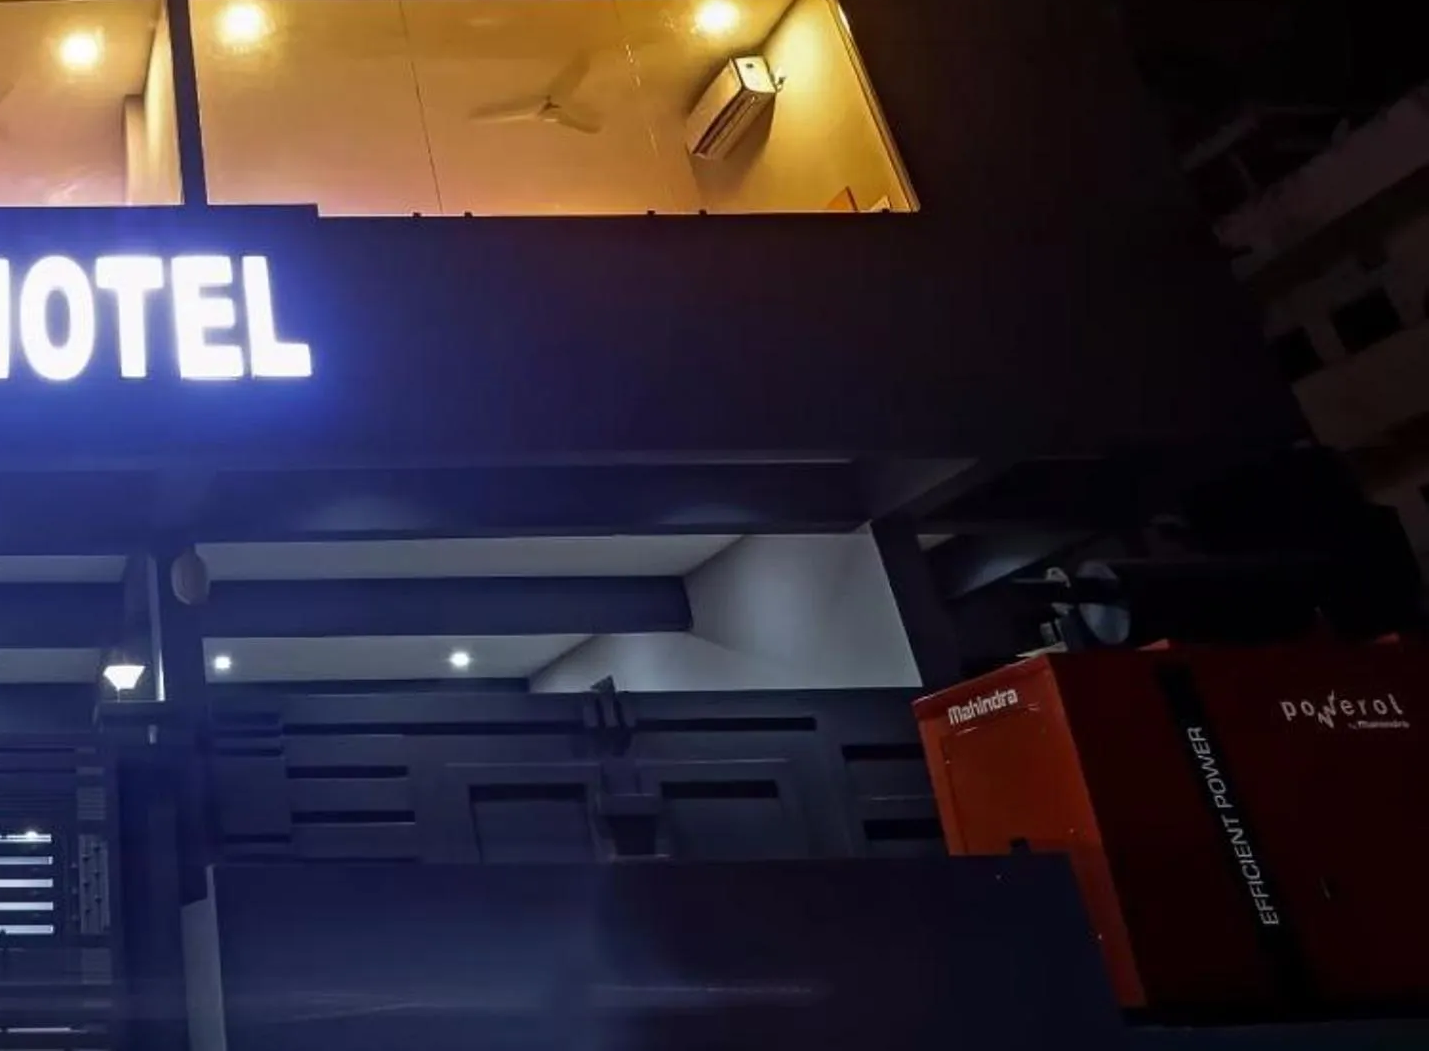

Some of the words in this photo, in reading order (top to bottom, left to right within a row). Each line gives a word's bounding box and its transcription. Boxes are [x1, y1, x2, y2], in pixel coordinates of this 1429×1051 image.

[947, 689, 1019, 726] Mahindra
[1186, 726, 1234, 809] POWER
[1220, 813, 1280, 926] EFFICIENT
